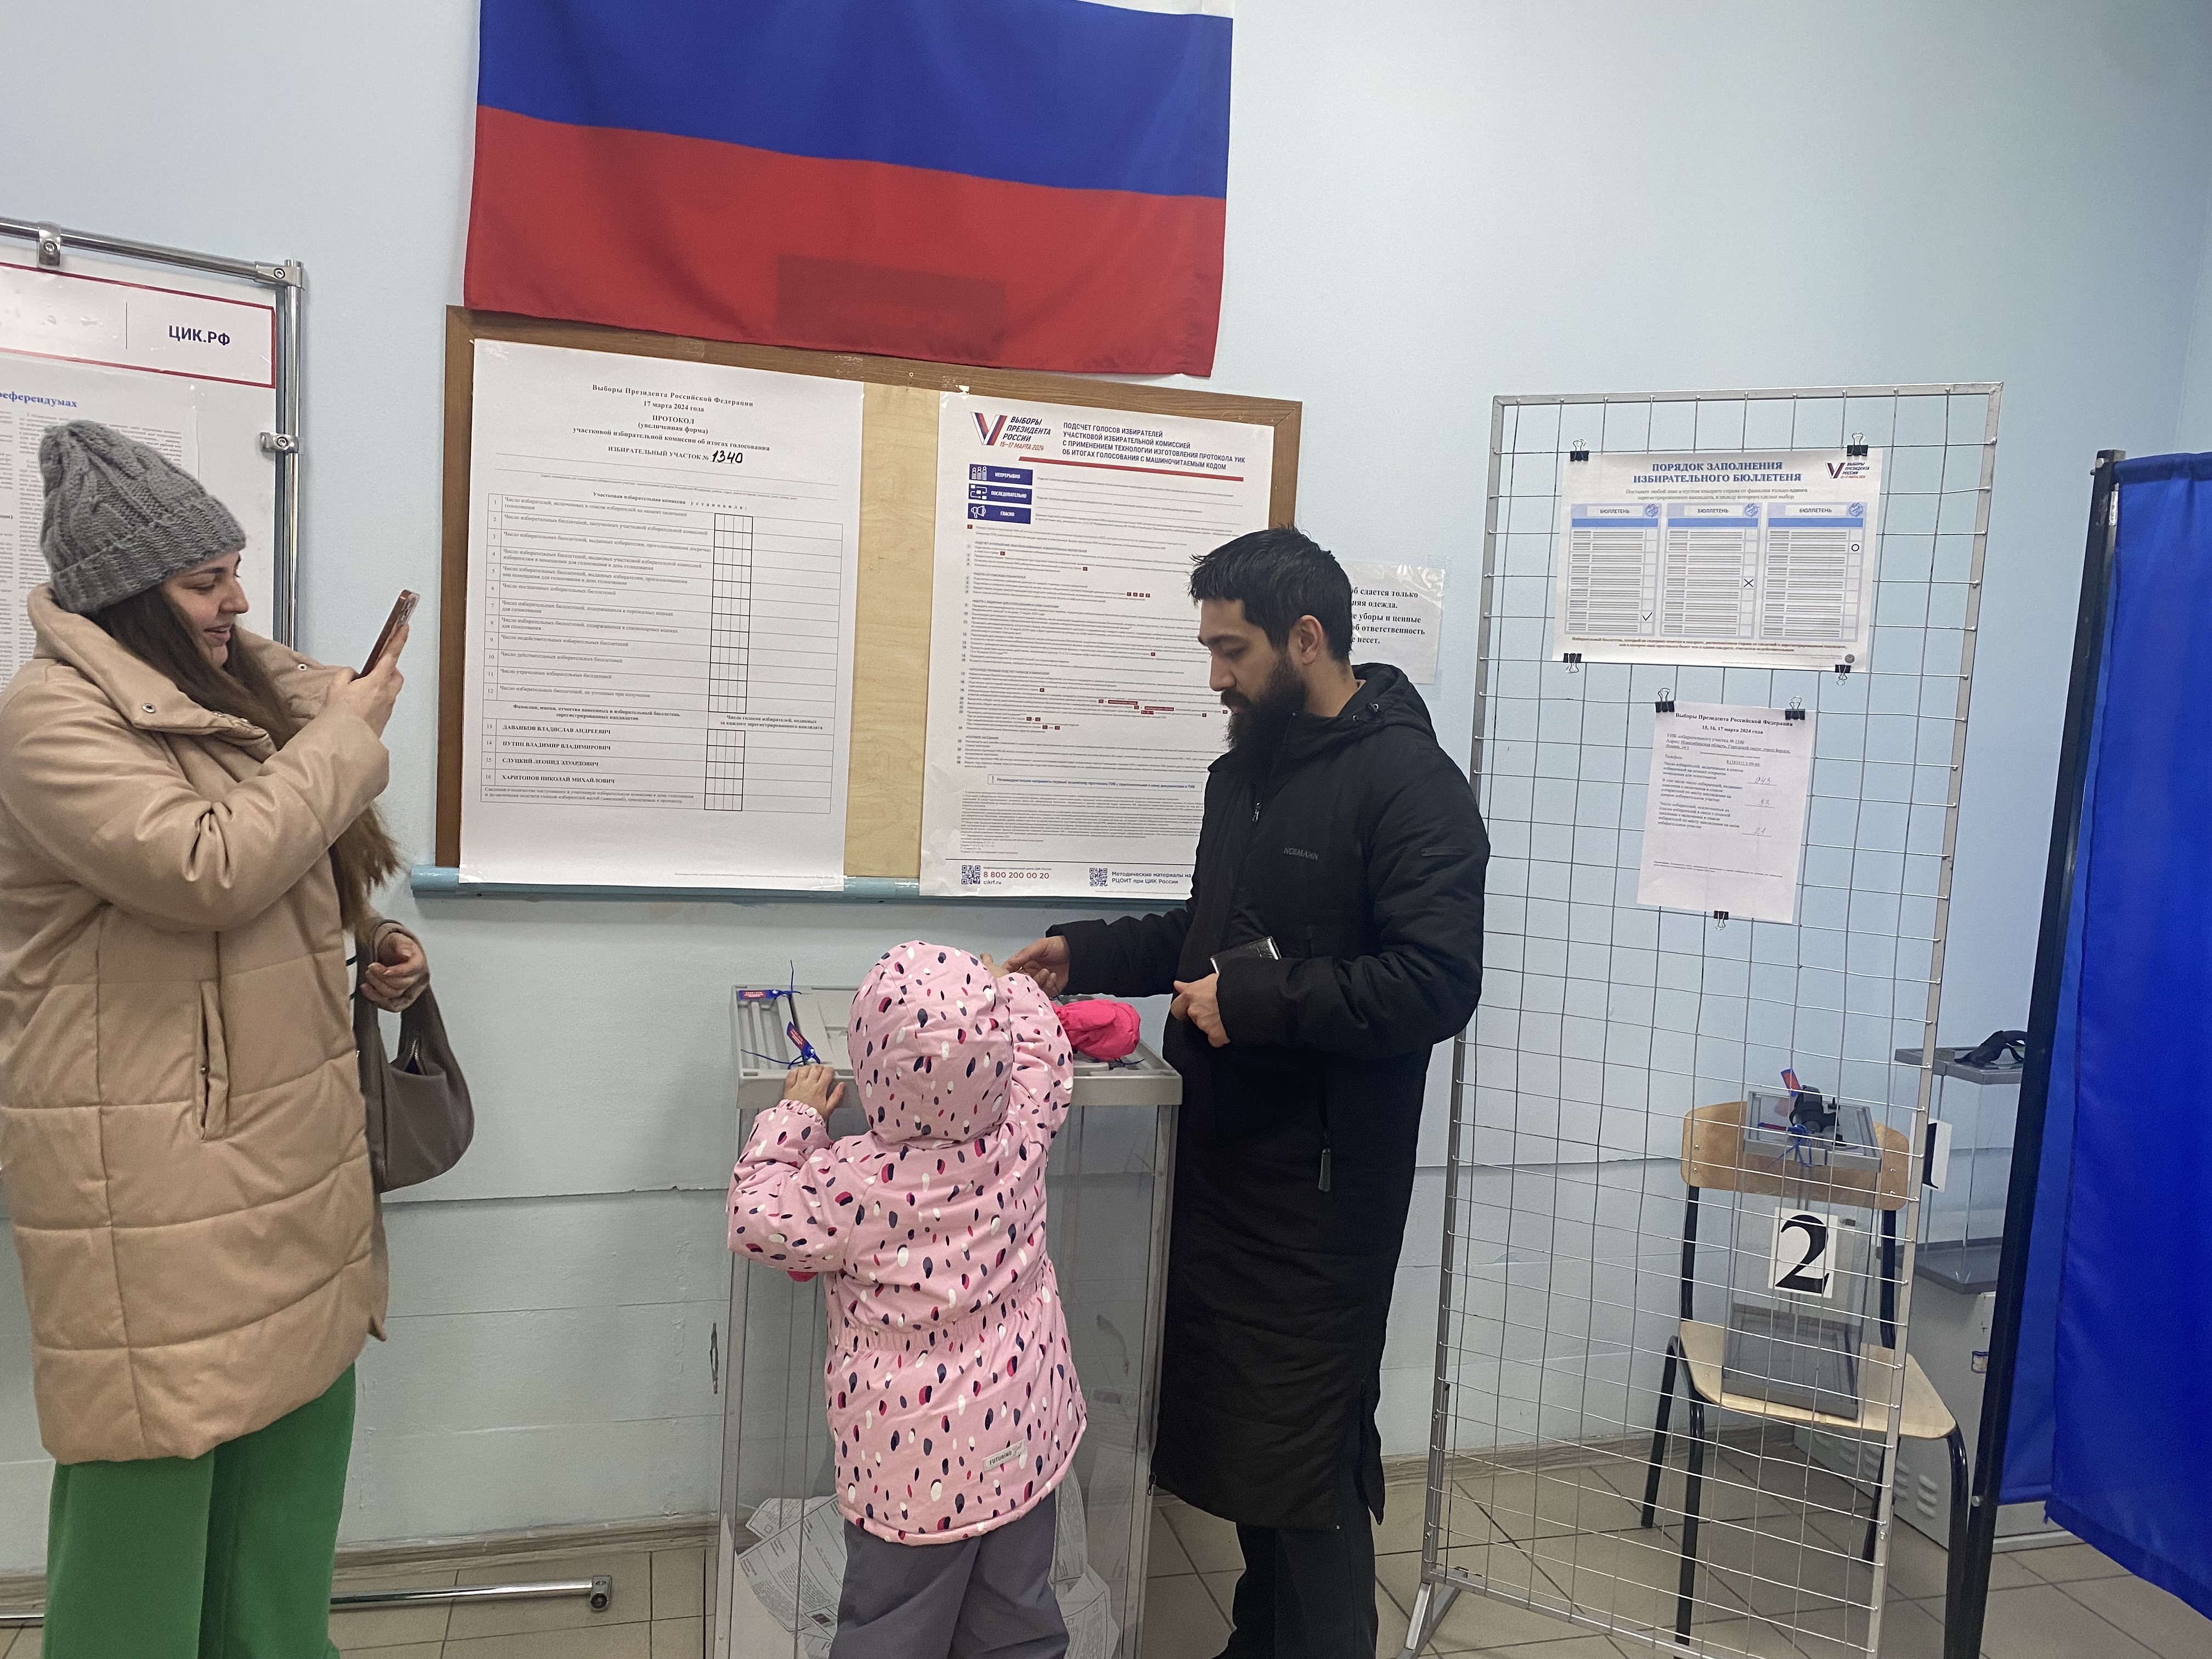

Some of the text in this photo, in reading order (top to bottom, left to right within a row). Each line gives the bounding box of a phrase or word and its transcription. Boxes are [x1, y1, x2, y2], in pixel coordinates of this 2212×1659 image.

[168, 325, 230, 346] ЦИК.РФ
[592, 384, 753, 407] Выборы Президента Российской Федерации
[652, 415, 694, 425] ПРОТОКОЛ
[1011, 416, 1042, 425] ВЫБОРЫ
[638, 422, 708, 435] (увеличенная форма)
[1007, 425, 1051, 435] ПРЕЗИДЕНТА
[1063, 422, 1163, 438] ПОДСЧЕТ ГОЛОСОВ ИЗБИРАТЕЛЕЙ
[573, 427, 611, 436] участковой
[613, 430, 663, 441] избирательной
[665, 435, 696, 443] комиссии
[730, 442, 770, 451] голосования
[1003, 433, 1031, 442] РОССИИ
[1063, 431, 1190, 449] УЧАСТКОВОЙ ИЗБИРАТЕЛЬНОЙ КОМИССИЕЙ
[608, 446, 668, 456] ИЗБИРАТЕЛЬНЫЙ
[669, 451, 702, 460] УЧАСТОК
[712, 450, 743, 464] 1340
[1068, 441, 1113, 450] ПРИМЕНЕНИЕМ
[1115, 445, 1152, 454] ТЕХНОЛОГИИ
[1154, 448, 1198, 459] ИЗГОТОВЛЕНИЯ
[1199, 453, 1233, 462] ПРОТОКОЛА
[1096, 452, 1139, 461] ГОЛОСОВАНИЯ
[1146, 456, 1205, 468] МАШИНОЧИТАЕМЫМ
[1652, 462, 1782, 472] ПОРЯДОК ЗАПОЛНЕНИЯ
[1633, 473, 1802, 483] ИЗБИРАТЕЛЬНОГО БЮЛЛЕТЕНЯ
[1359, 613, 1383, 622] уборы
[1393, 616, 1421, 624] ценные
[1362, 625, 1425, 635] ответственность
[1774, 1214, 1830, 1294] 2
